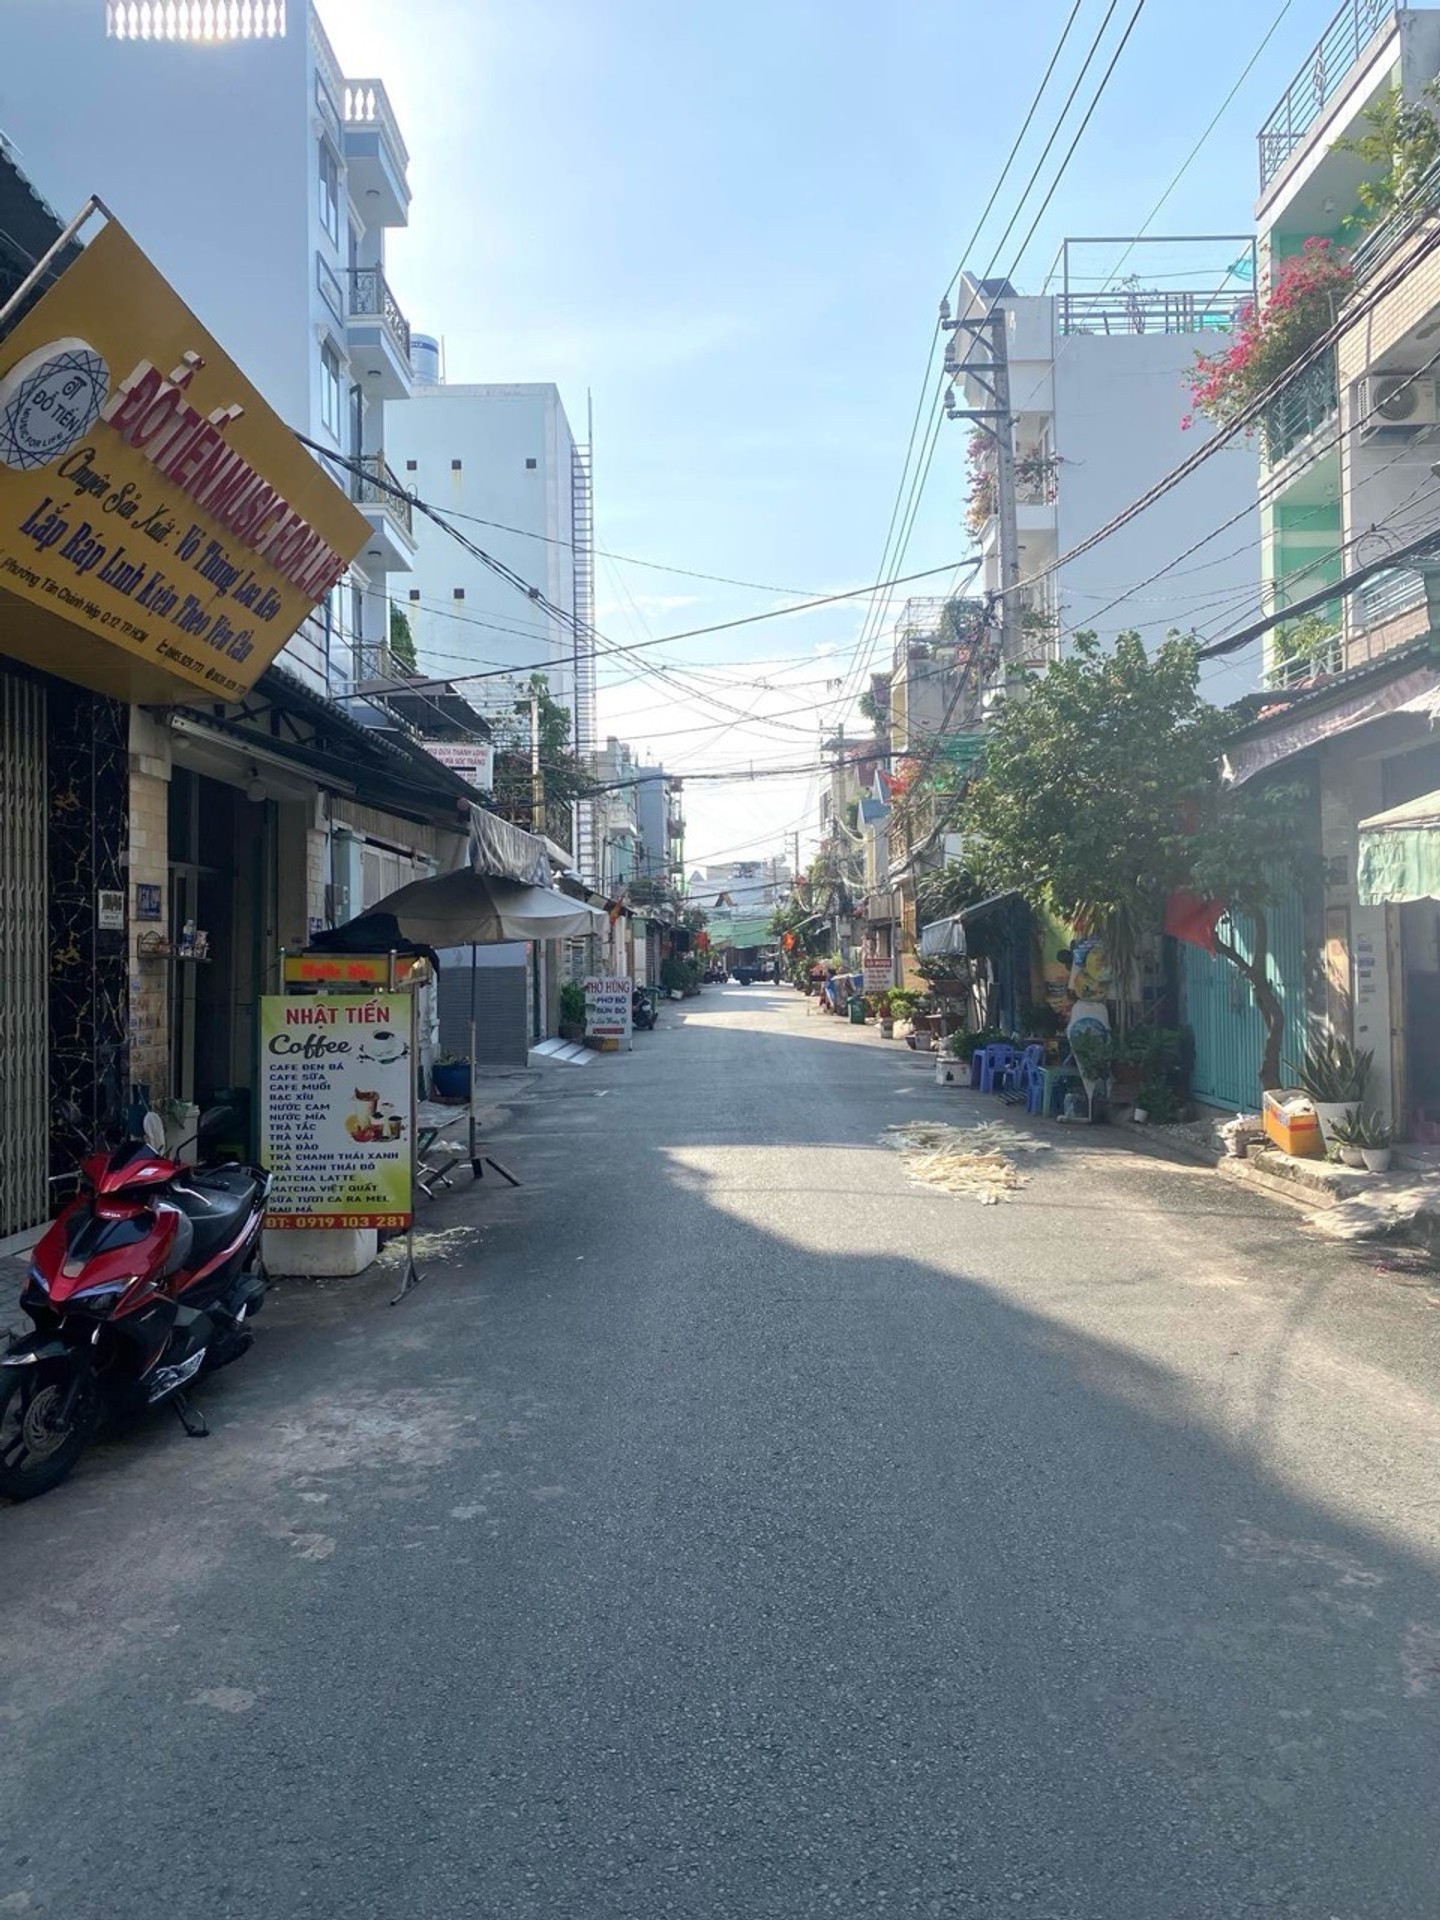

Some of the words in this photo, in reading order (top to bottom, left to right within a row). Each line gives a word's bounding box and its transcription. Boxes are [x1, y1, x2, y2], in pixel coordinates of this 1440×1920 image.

[19, 407, 33, 439] MUSIC
[26, 436, 41, 447] FOR
[43, 432, 64, 447] LIFE
[58, 447, 111, 499] Chuyên
[103, 483, 142, 520] Sản
[174, 523, 206, 562] Vỏ
[193, 539, 244, 597] Thùng
[232, 570, 262, 609] Loa
[253, 586, 281, 622] Kéo
[204, 459, 289, 549] MUSIC
[265, 513, 320, 580] FOR
[294, 543, 349, 604] LIFE
[19, 497, 72, 552] Lắp
[59, 521, 107, 576] Ráp
[170, 593, 212, 636] Theo
[203, 614, 234, 651] Yêu
[57, 587, 84, 609] Chánh
[606, 978, 629, 993] HÙNG
[286, 1003, 339, 1029] NHẬT
[345, 999, 390, 1024] TIẾN
[268, 1033, 352, 1059] Coffee
[328, 1062, 344, 1071] ĐÁ
[302, 1073, 326, 1081] SỮA
[302, 1081, 331, 1091] MUỐI
[296, 1092, 314, 1100] XÍU
[269, 1103, 301, 1111] NƯỚC
[269, 1113, 301, 1121] NƯỚC
[305, 1112, 327, 1120] MÍA
[269, 1122, 291, 1131] TRÀ
[269, 1133, 291, 1141] TRÀ
[269, 1143, 292, 1151] TRÀ
[295, 1142, 319, 1150] ĐÀO
[269, 1153, 292, 1161] TRÀ
[338, 1152, 364, 1160] THÁI
[367, 1152, 399, 1160] XANH
[270, 1163, 292, 1171] TRÀ
[330, 1163, 357, 1171] THÁI
[319, 1185, 345, 1194] VIỆT
[348, 1182, 378, 1192] QUẤT
[270, 1195, 292, 1203] SỮA
[298, 1195, 324, 1203] TƯƠI
[295, 1205, 314, 1213] MÁ
[266, 1217, 290, 1228] ĐT:
[295, 1216, 335, 1228] 0919
[342, 1216, 369, 1227] 103
[376, 1216, 405, 1227] 281
